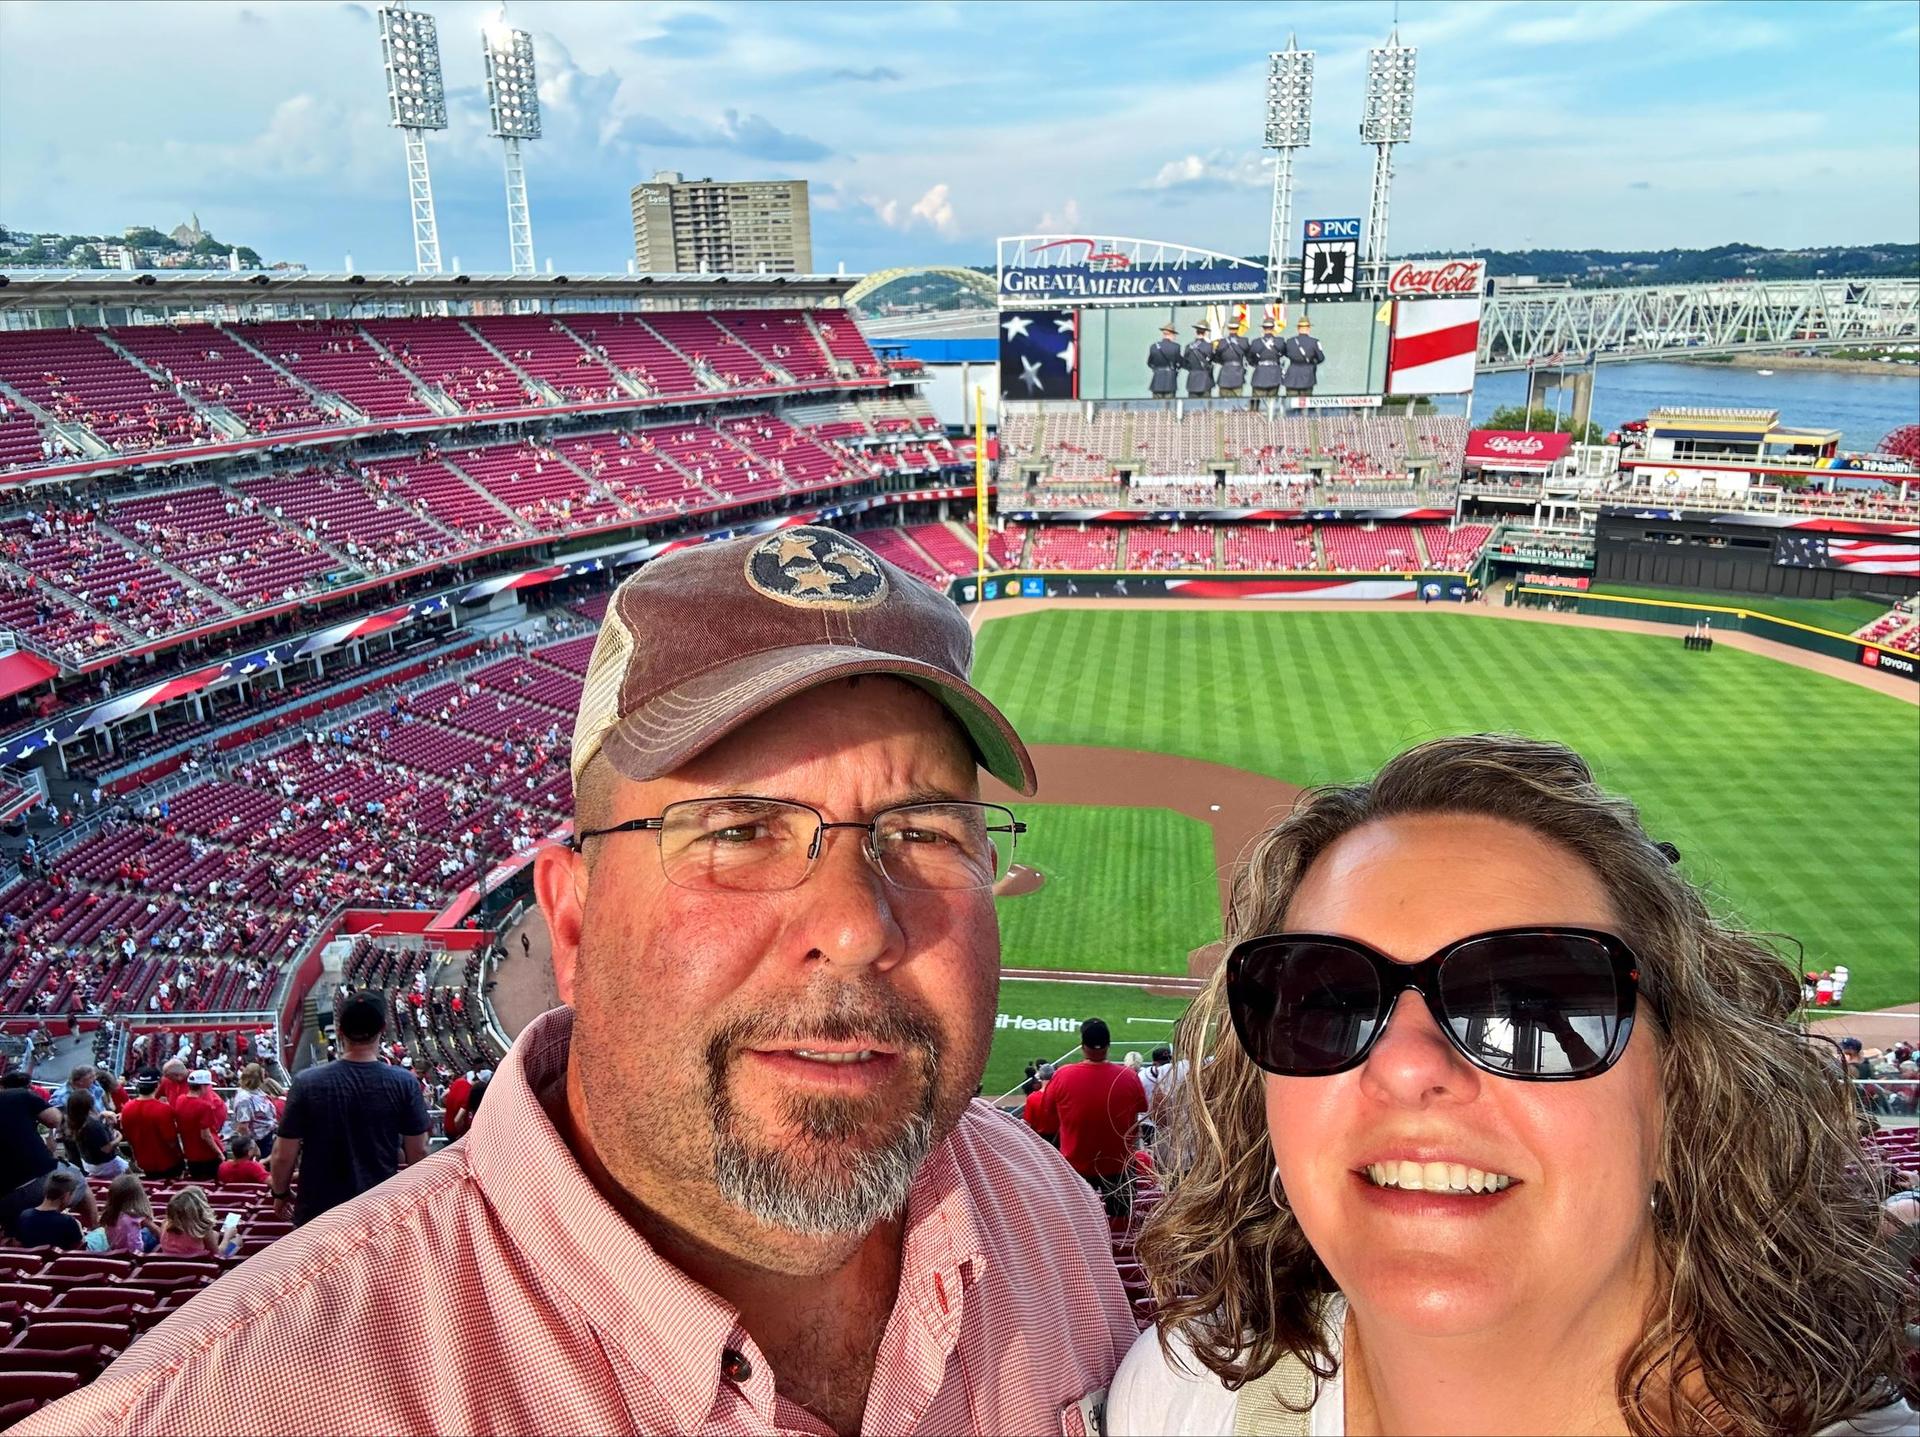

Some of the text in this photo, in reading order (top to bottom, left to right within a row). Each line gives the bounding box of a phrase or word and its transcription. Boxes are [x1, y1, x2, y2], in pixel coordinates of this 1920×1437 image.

[1324, 220, 1359, 235] PNC
[1389, 262, 1482, 293] Coca-Cola
[1187, 282, 1231, 292] INSURANCE
[1232, 281, 1259, 291] GROUP
[1484, 436, 1544, 451] Reds
[1862, 460, 1908, 473] TriHealth
[1548, 550, 1564, 559] FOR
[1566, 551, 1586, 561] LESS
[1880, 655, 1914, 673] TOYOTA
[994, 1013, 1083, 1033] iHealth
